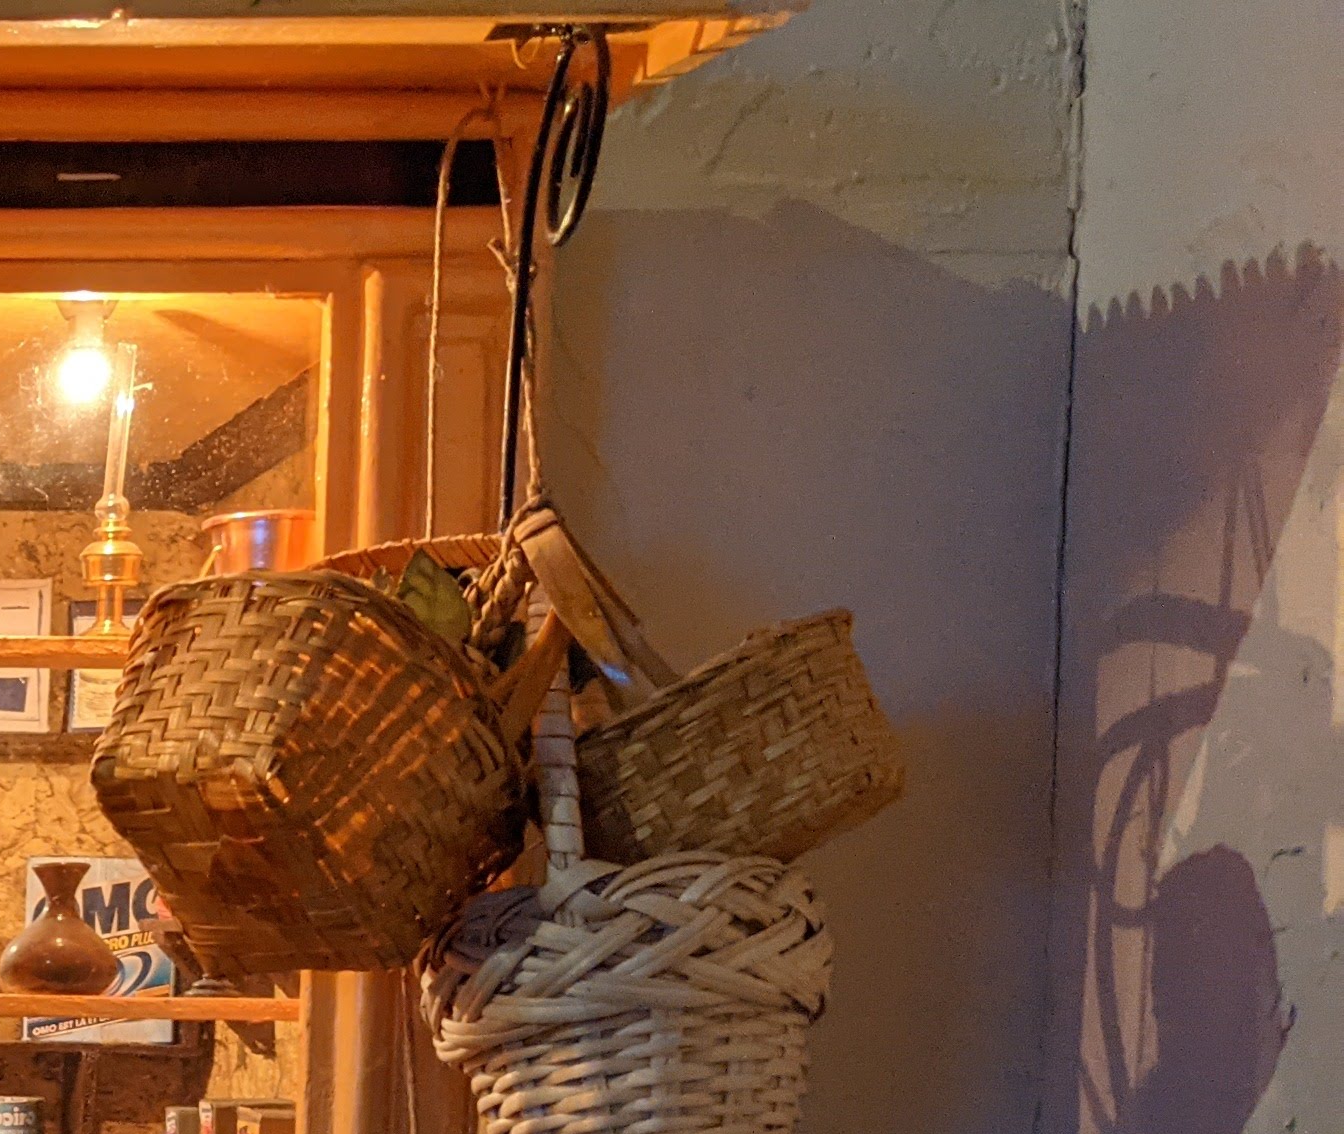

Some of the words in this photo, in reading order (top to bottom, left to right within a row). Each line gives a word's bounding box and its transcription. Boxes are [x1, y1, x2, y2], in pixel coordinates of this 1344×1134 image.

[32, 878, 160, 934] MO
[32, 1024, 57, 1037] OMO
[58, 1020, 74, 1031] EST
